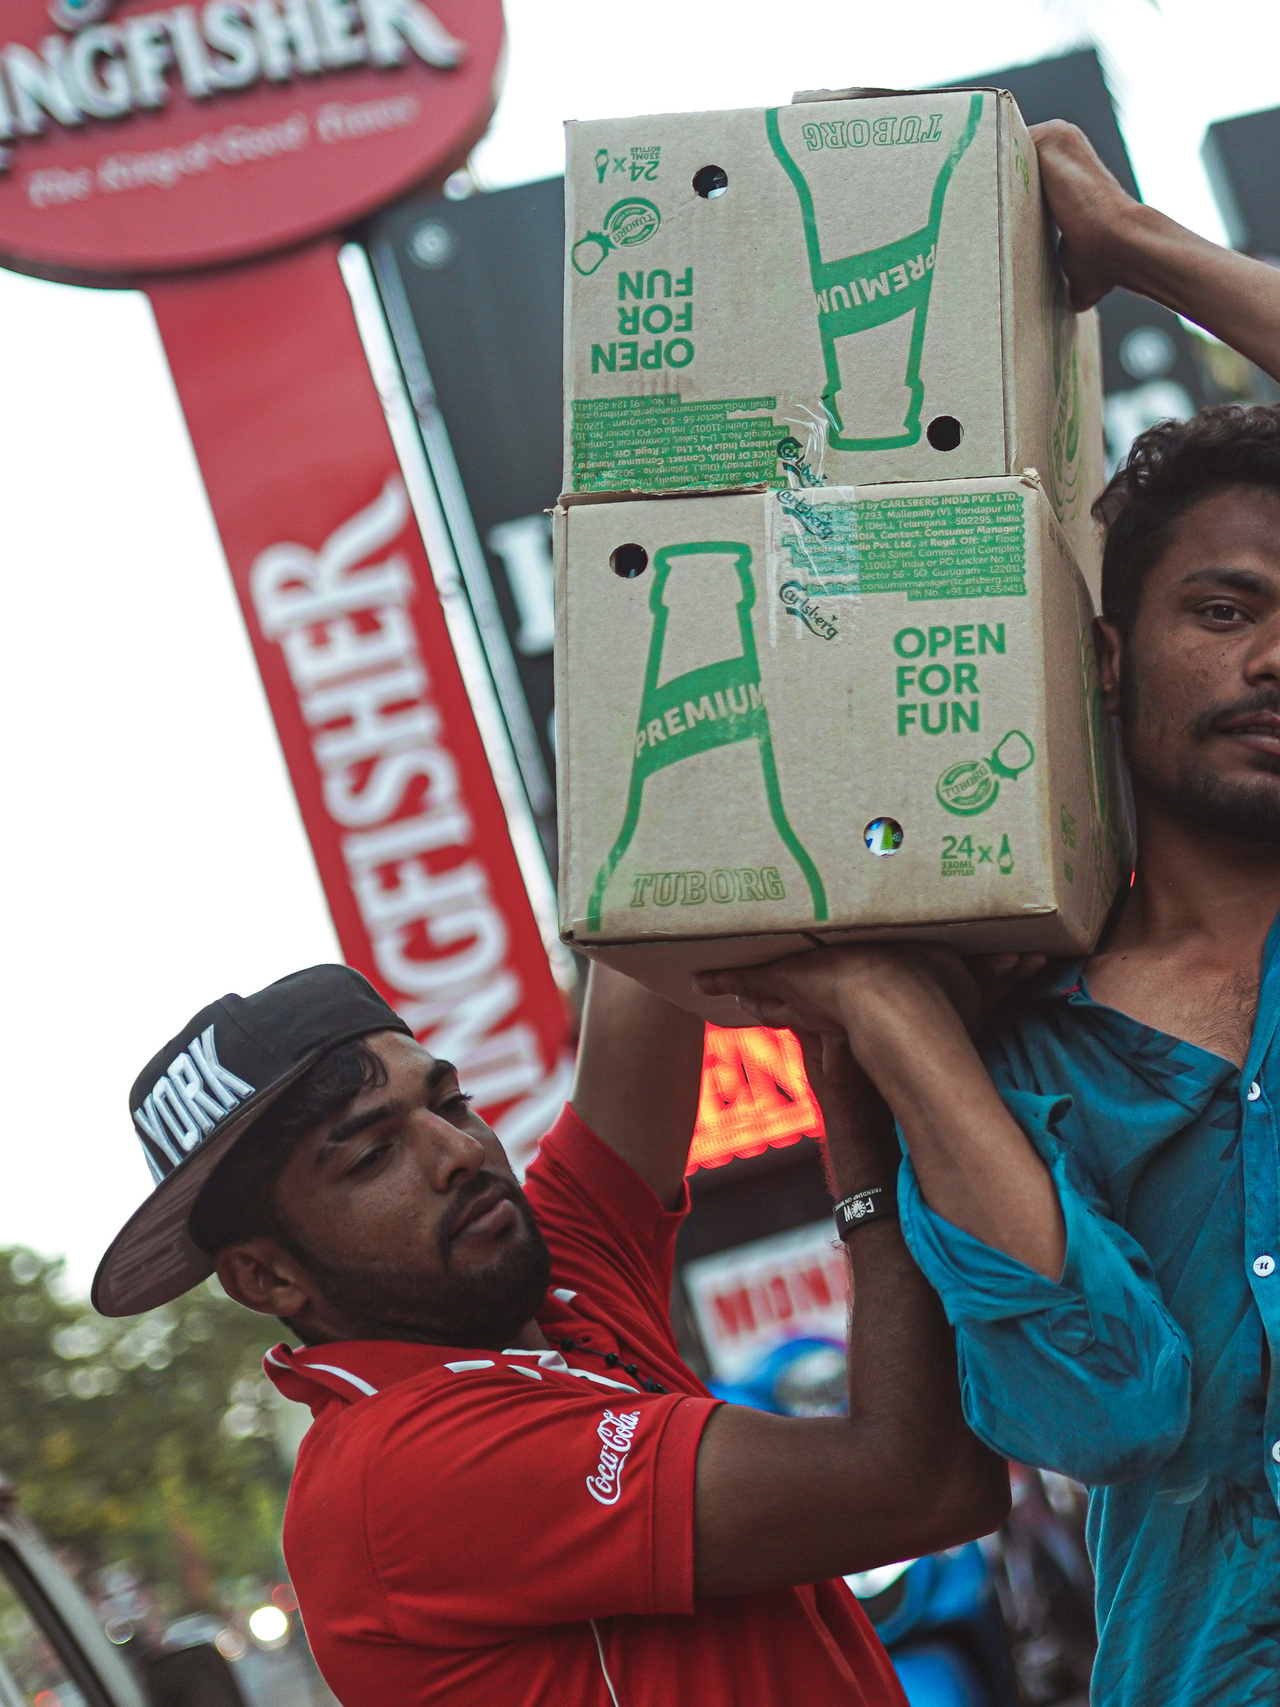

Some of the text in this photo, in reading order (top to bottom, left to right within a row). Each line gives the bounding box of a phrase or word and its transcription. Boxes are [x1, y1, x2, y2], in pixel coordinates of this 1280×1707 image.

[803, 111, 943, 152] TUBORG
[629, 161, 660, 181] 24
[613, 213, 656, 243] TUBORG
[618, 267, 694, 301] FUN
[816, 244, 936, 314] PREMIUM
[617, 302, 694, 336] FOR
[590, 337, 695, 375] OPEN
[694, 442, 712, 451] Pvt.
[707, 452, 735, 461] INDIA.
[714, 441, 737, 450] India
[737, 451, 749, 459] OF
[616, 456, 663, 466] Consumer
[866, 500, 878, 509] by
[880, 497, 938, 509] CARLSBERG
[941, 496, 969, 505] INDIA
[971, 494, 993, 504] PVT.
[955, 504, 1000, 515] Kondapur
[880, 529, 922, 539] Contact:
[924, 526, 975, 537] Consumer
[897, 518, 946, 528] Telangana
[873, 541, 891, 550] Pvt.
[930, 537, 957, 547] Regd.
[918, 546, 975, 557] Commercial
[901, 559, 924, 568] India
[939, 557, 953, 566] PO
[956, 556, 987, 565] Locker
[860, 571, 889, 581] Sector
[964, 585, 981, 594] 124
[779, 580, 839, 641] Carlsberg
[893, 623, 1006, 659] OPEN
[897, 664, 979, 698] FOR
[634, 683, 763, 757] PREMIUM
[897, 702, 980, 736] FUN
[942, 765, 989, 797] TUBORG
[941, 835, 975, 860] 24
[941, 861, 974, 869] 330ML
[629, 867, 786, 909] TUBORG
[133, 1023, 257, 1169] YORK
[586, 1408, 641, 1506] Coca-Cola
